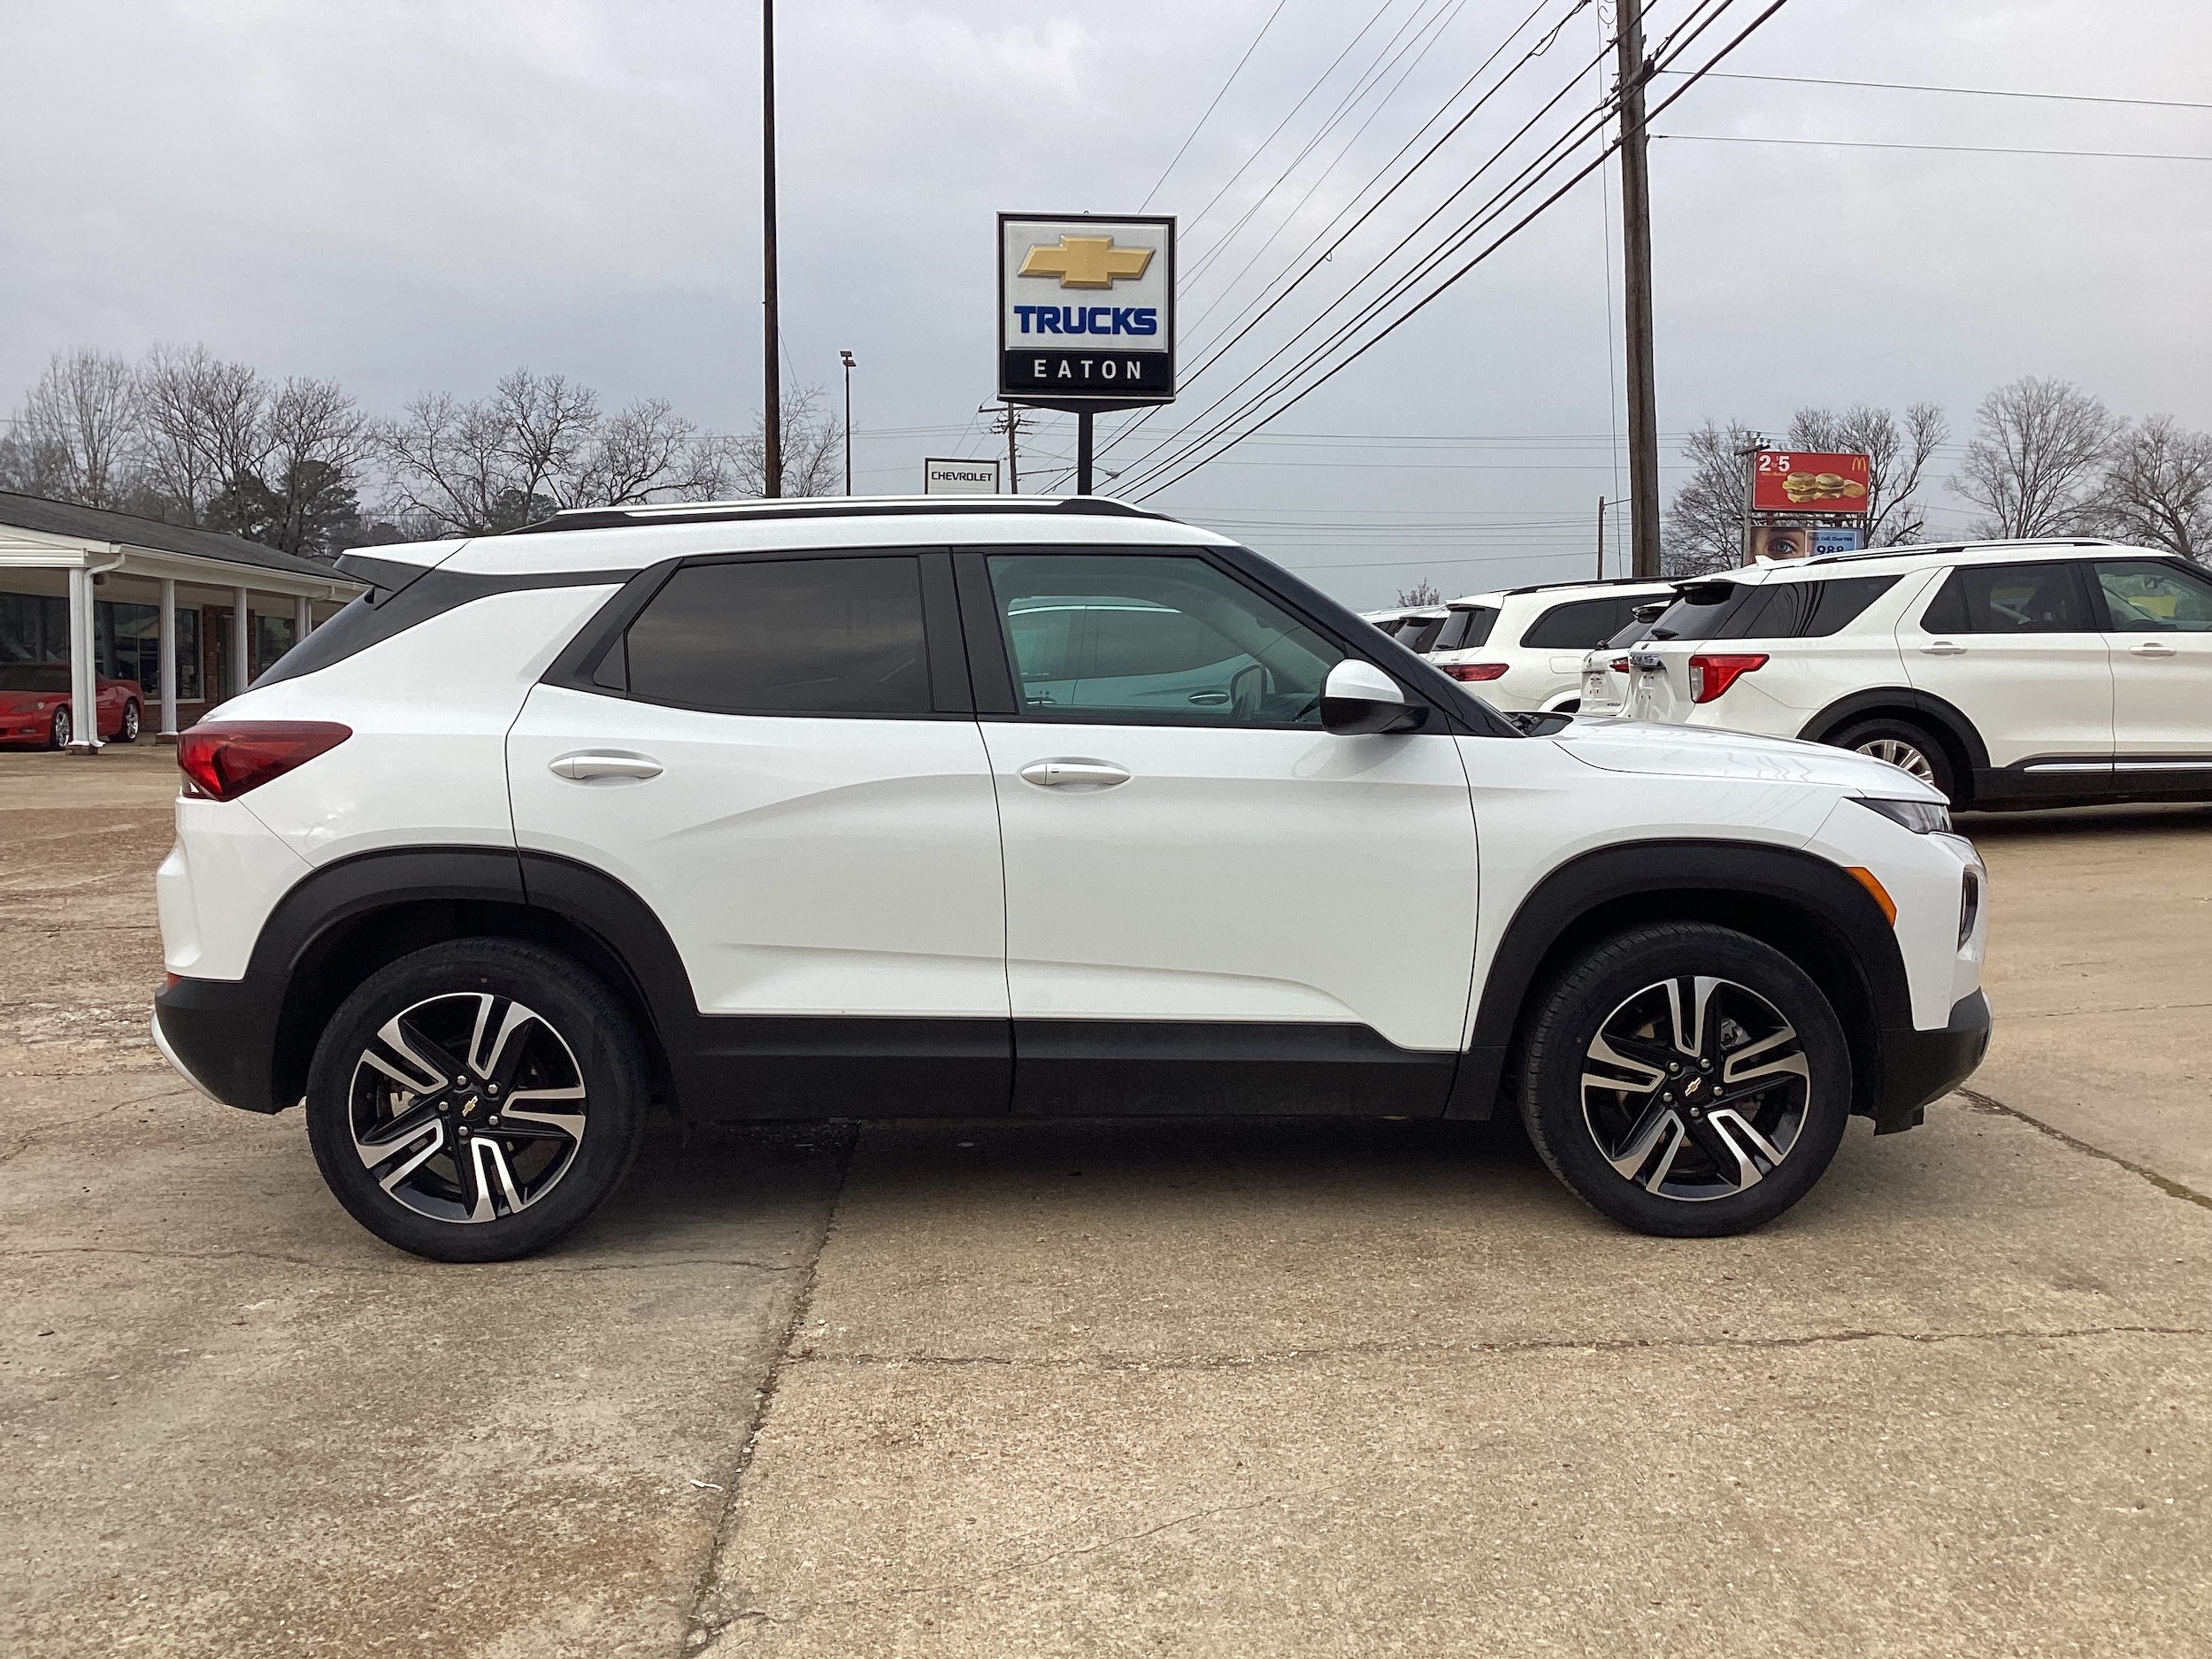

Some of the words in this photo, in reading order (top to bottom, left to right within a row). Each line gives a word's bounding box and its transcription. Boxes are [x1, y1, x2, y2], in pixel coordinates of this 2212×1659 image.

[1013, 305, 1157, 335] TRUCKS
[1033, 359, 1141, 380] EATON
[1758, 454, 1771, 471] 2
[931, 471, 993, 482] CHEVROLET
